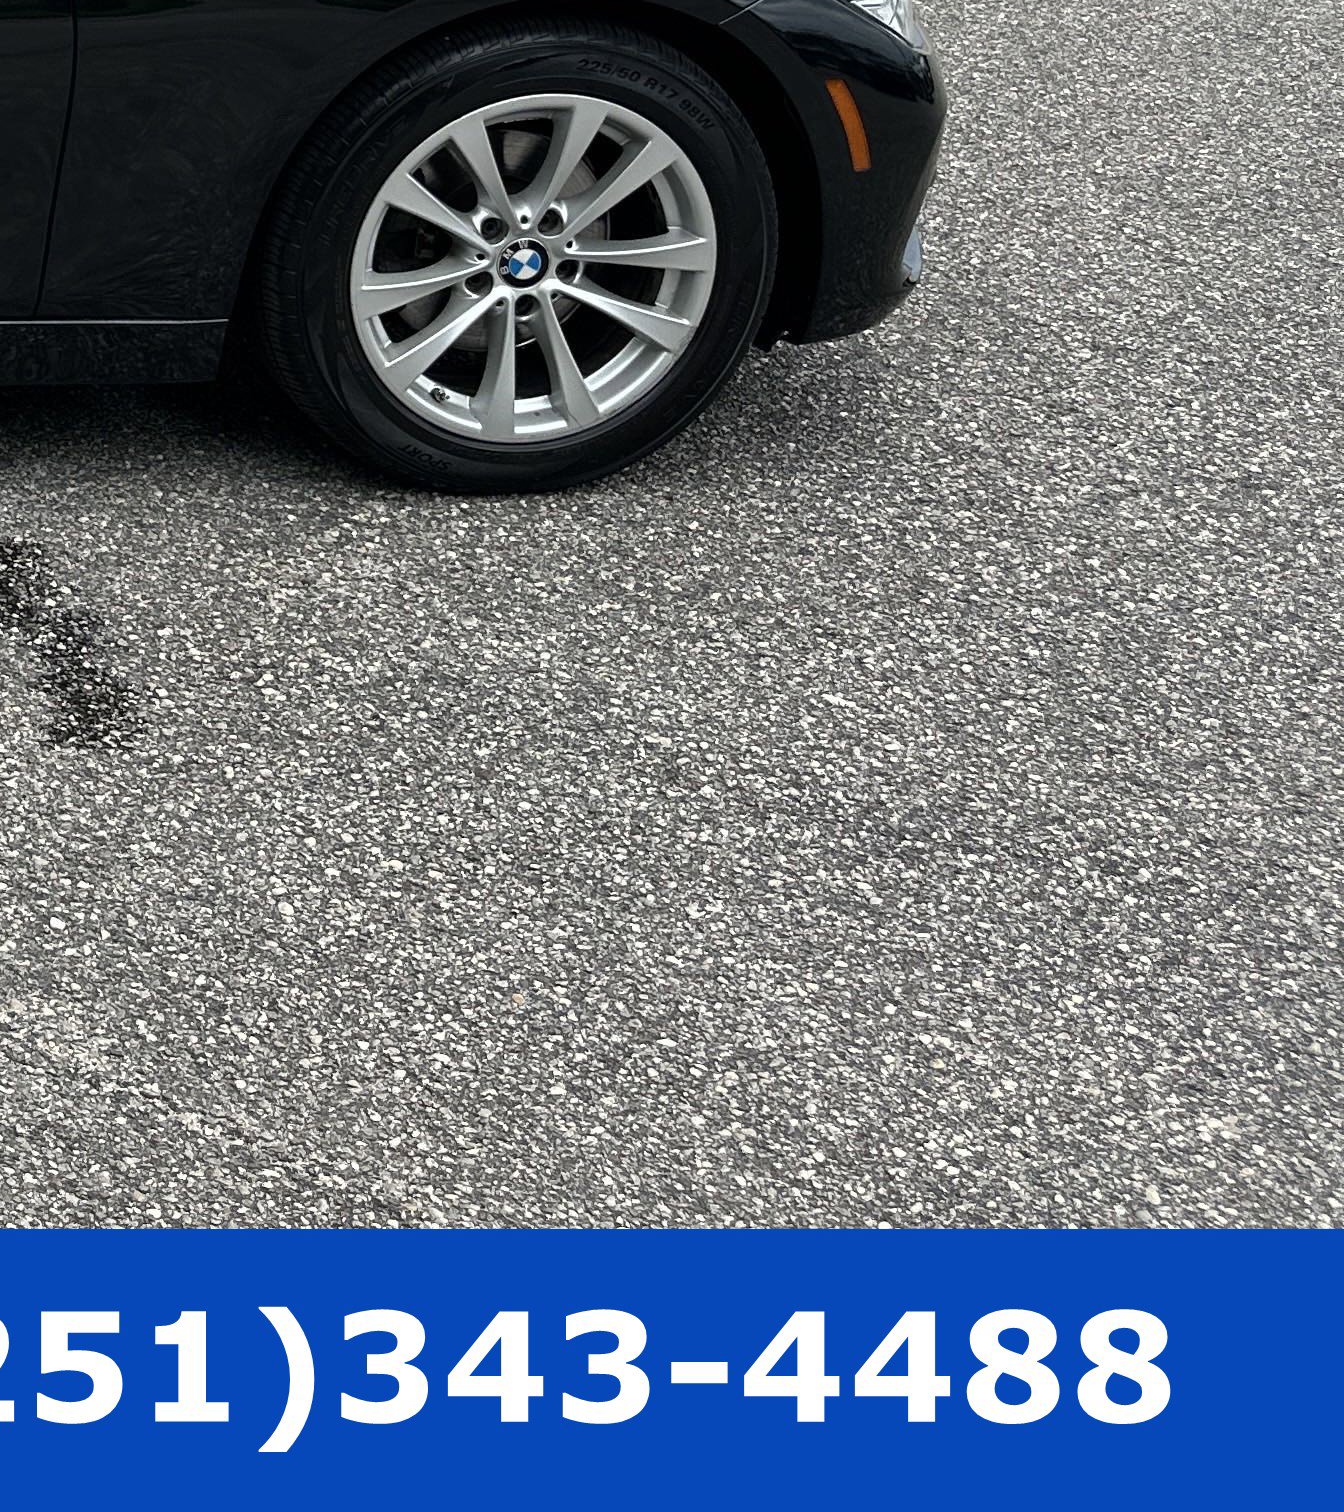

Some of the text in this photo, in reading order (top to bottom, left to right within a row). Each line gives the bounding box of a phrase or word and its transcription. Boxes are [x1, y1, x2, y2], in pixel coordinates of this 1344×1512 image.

[577, 58, 641, 82] 225/50
[644, 78, 679, 100] R17
[500, 239, 530, 276] BMW
